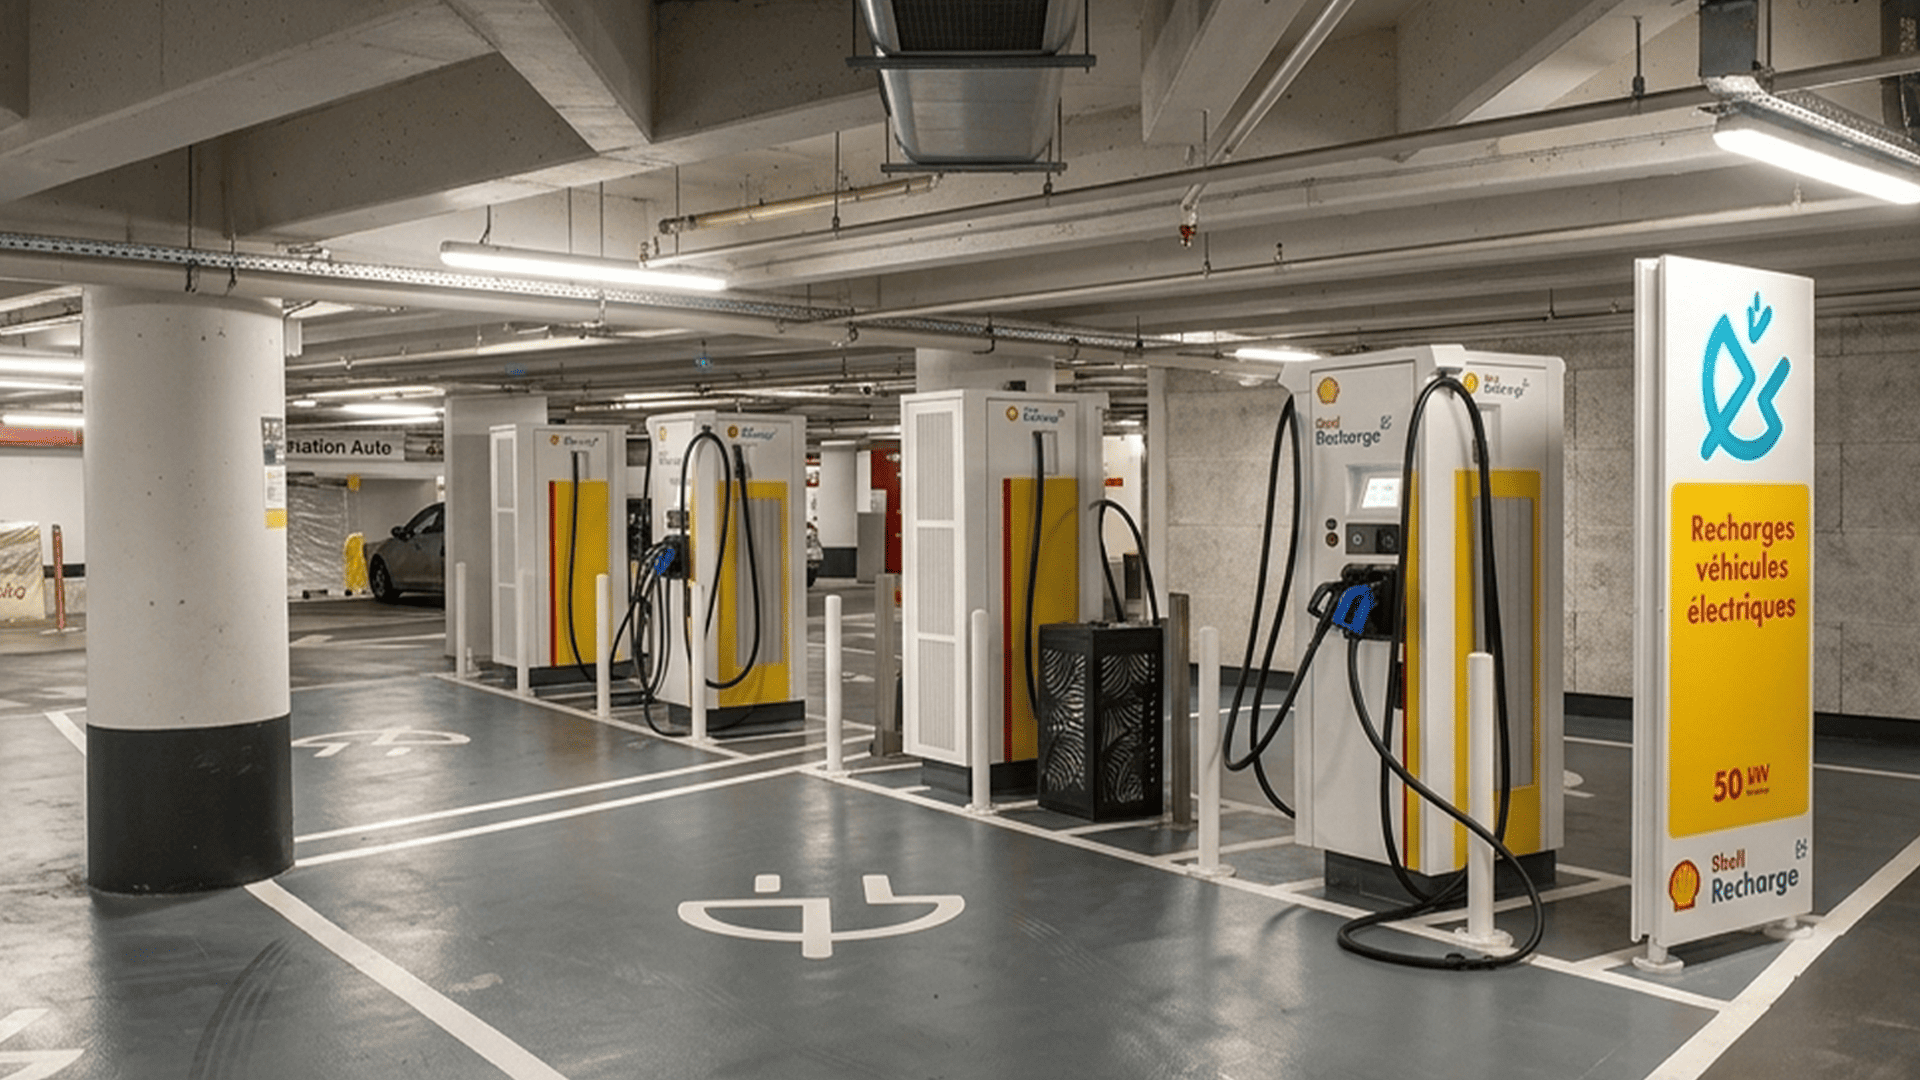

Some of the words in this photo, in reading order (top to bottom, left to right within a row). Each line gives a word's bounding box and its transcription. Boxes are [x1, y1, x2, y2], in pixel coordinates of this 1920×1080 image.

[1691, 512, 1795, 548] Recharges
[1695, 550, 1789, 581] véhicules
[1687, 593, 1796, 628] électriques
[1713, 767, 1744, 803] 50
[1712, 869, 1799, 904] Recharge
